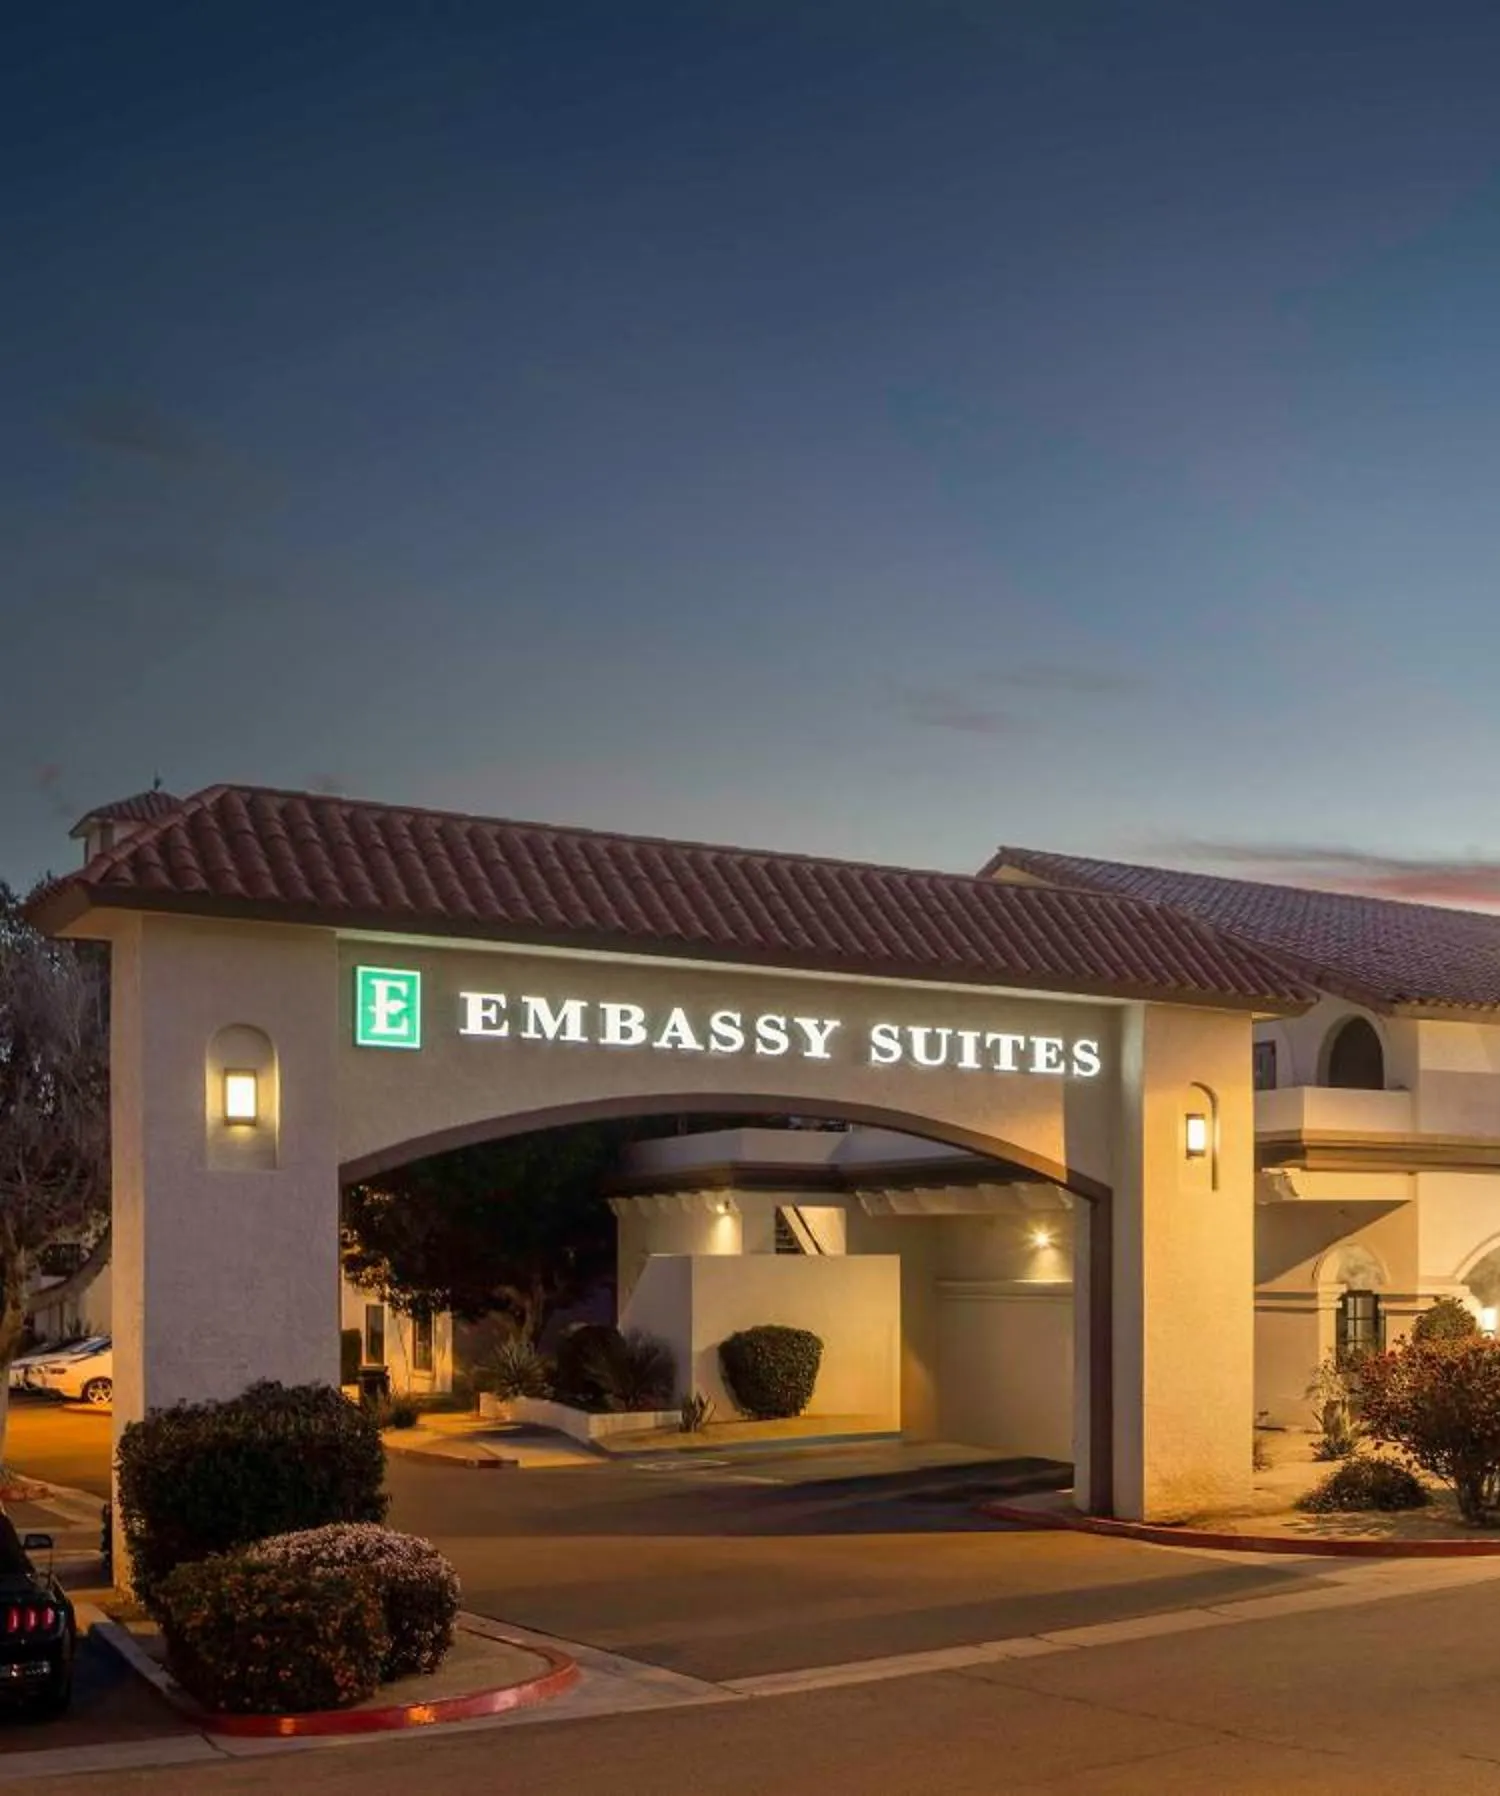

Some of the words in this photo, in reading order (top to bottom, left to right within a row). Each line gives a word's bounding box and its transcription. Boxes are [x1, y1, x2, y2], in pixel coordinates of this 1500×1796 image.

[369, 979, 409, 1036] E
[458, 991, 842, 1059] EMBASSY
[870, 1023, 1101, 1077] SUITES
